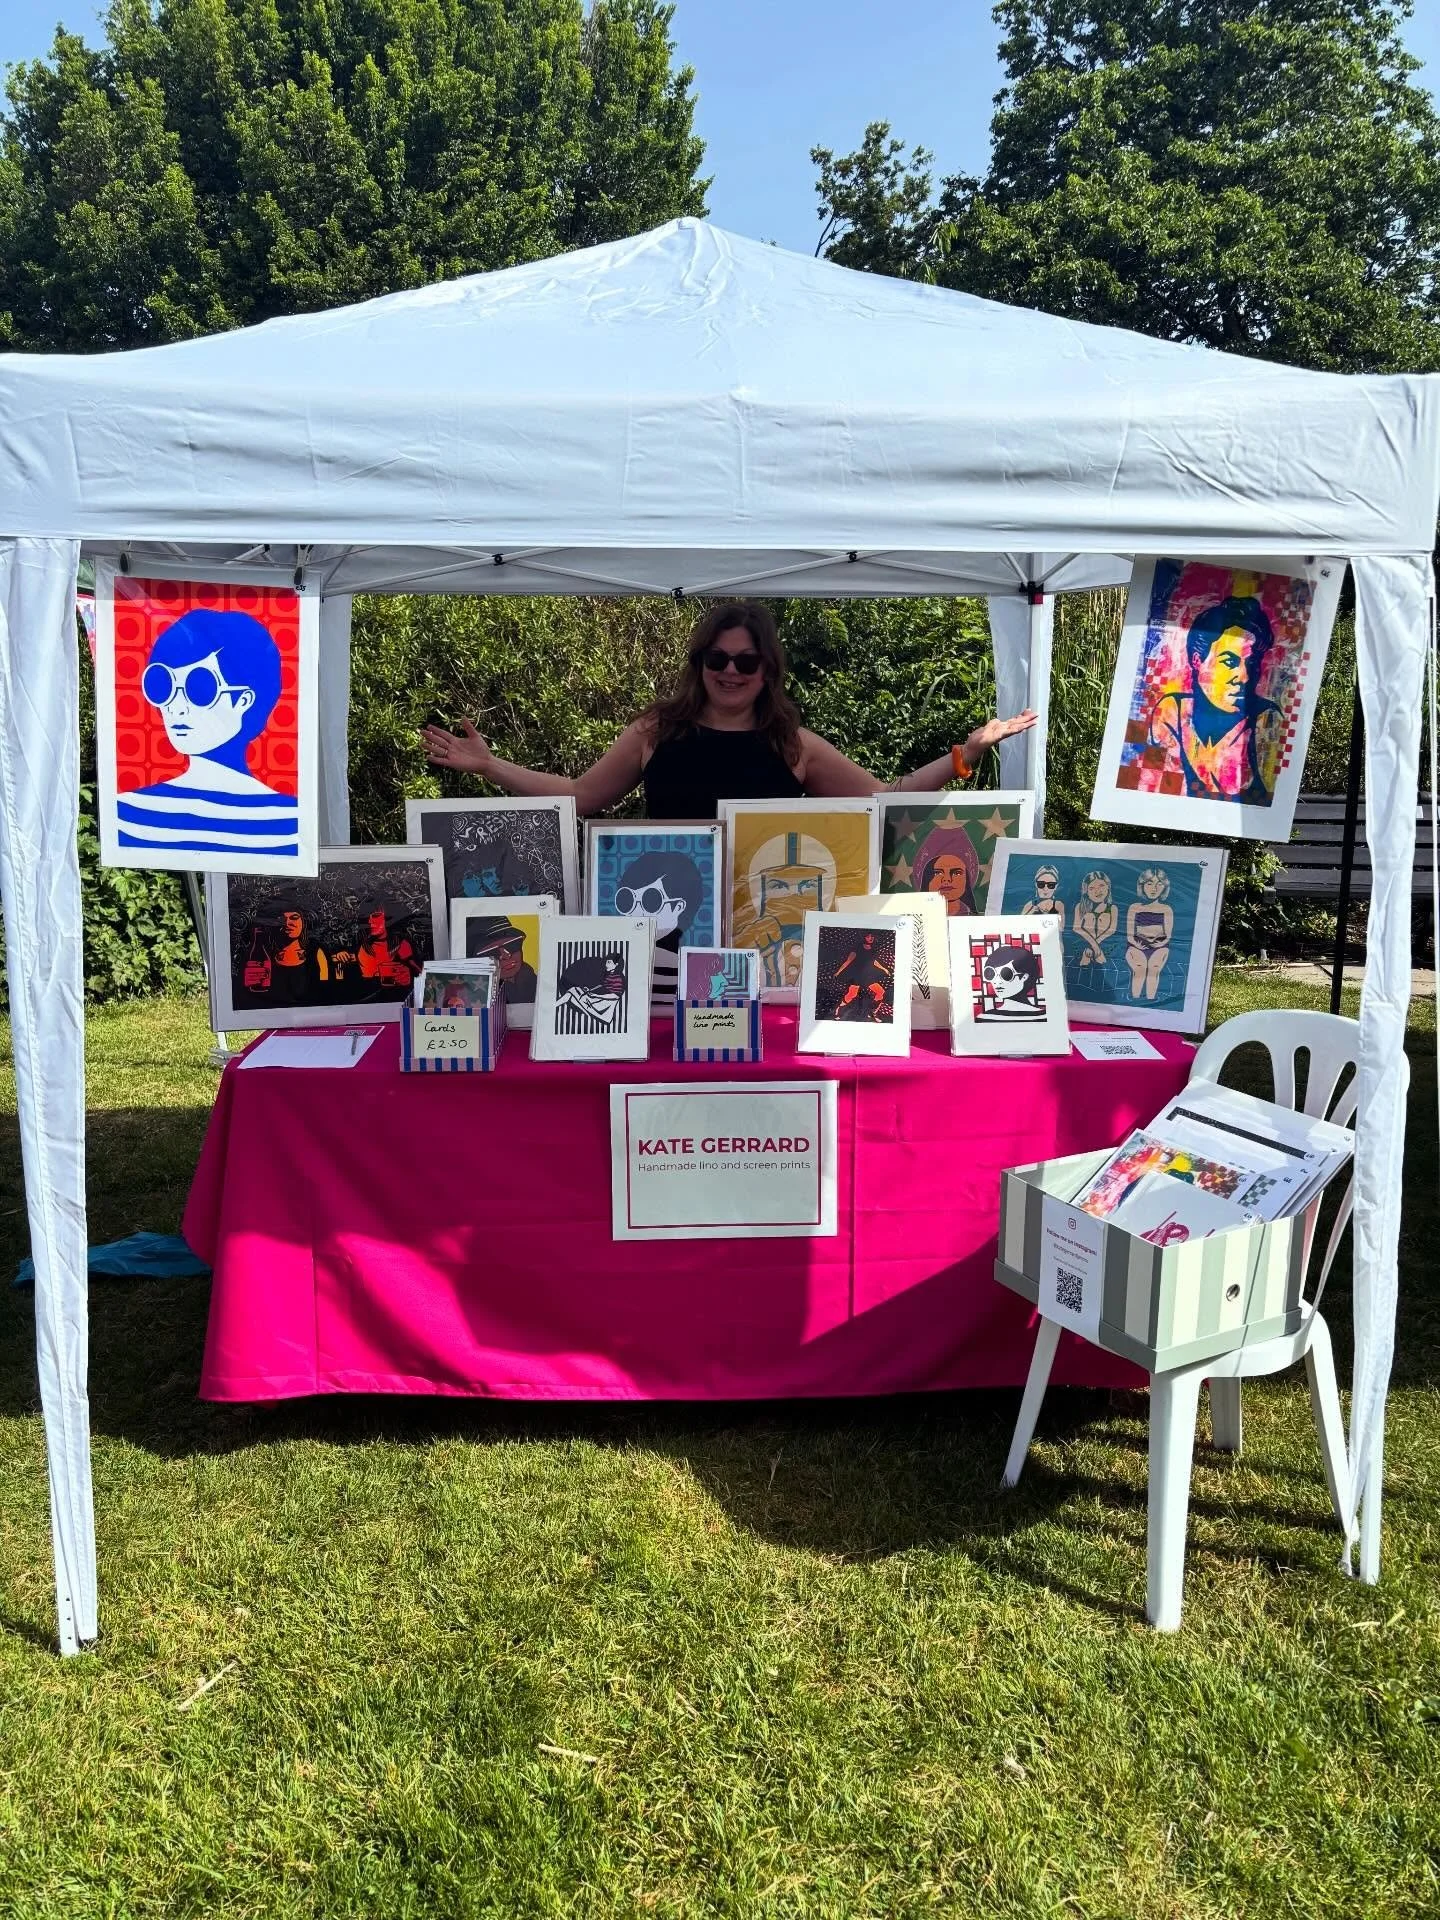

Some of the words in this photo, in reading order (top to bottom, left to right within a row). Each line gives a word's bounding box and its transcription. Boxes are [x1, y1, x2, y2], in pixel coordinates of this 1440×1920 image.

[693, 1012, 735, 1020] Handmade
[424, 1021, 456, 1033] Cards
[693, 1020, 709, 1028] lino
[712, 1021, 736, 1031] prints
[638, 1138, 695, 1156] KATE
[701, 1137, 810, 1154] GERRARD
[638, 1162, 697, 1172] Handmade
[699, 1161, 719, 1170] lino
[720, 1161, 741, 1170] and
[743, 1162, 778, 1170] screen
[780, 1161, 811, 1172] prints
